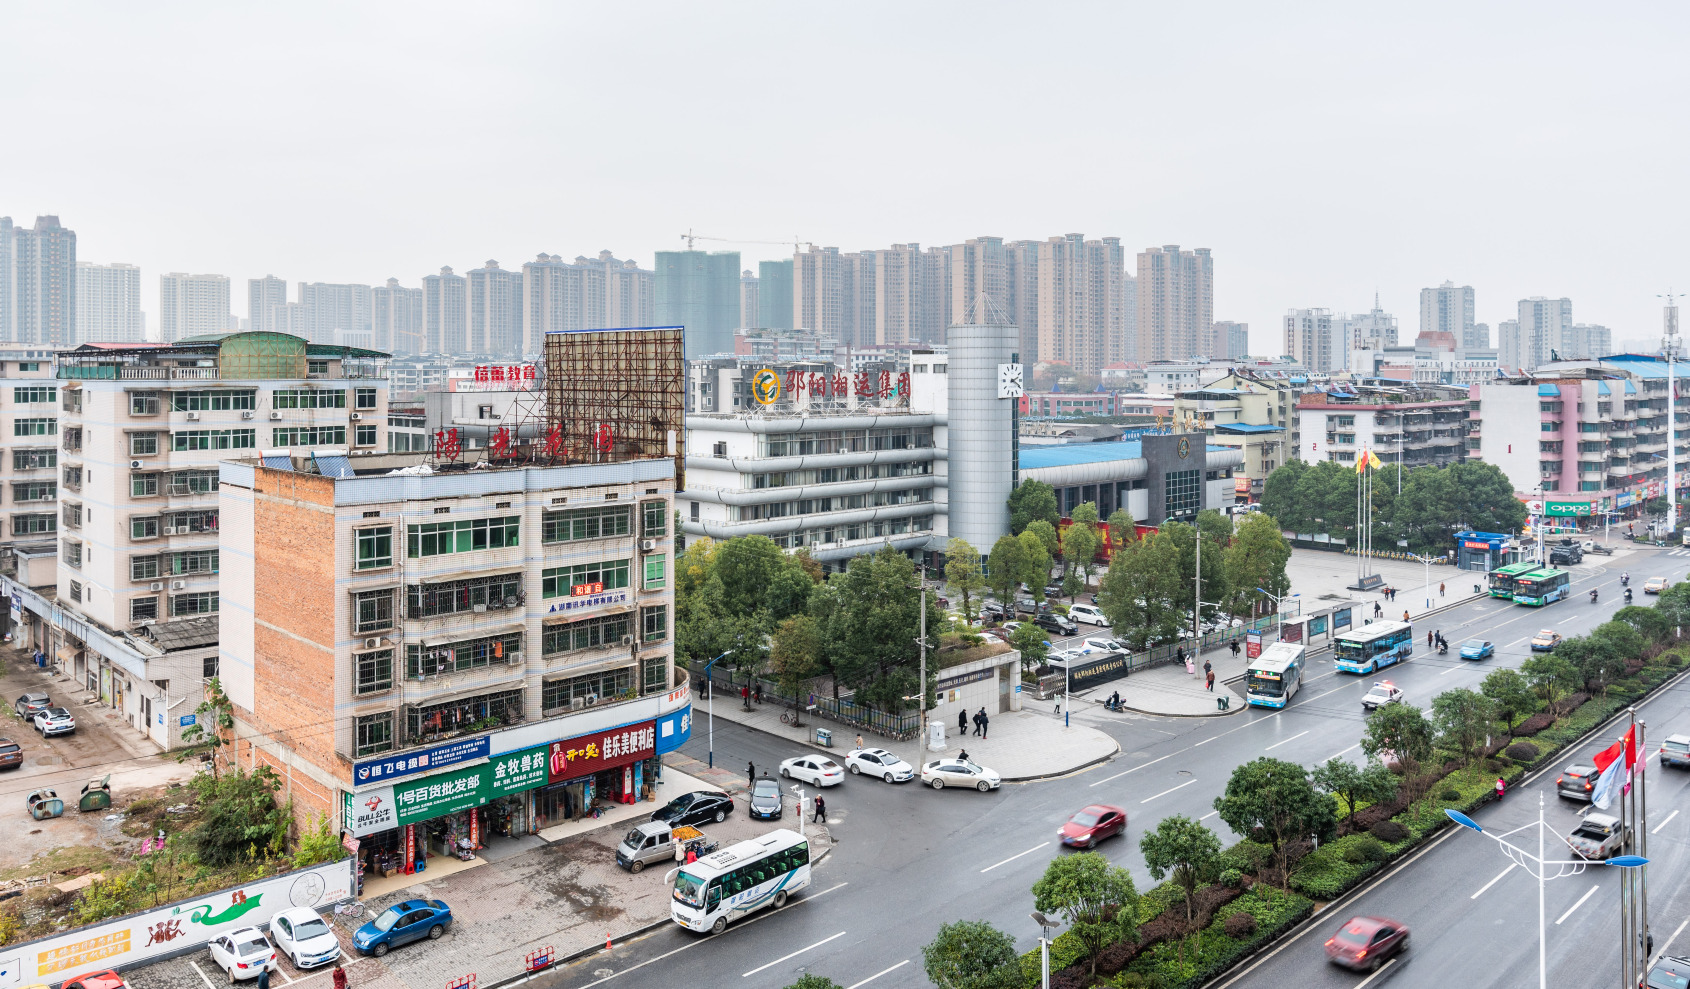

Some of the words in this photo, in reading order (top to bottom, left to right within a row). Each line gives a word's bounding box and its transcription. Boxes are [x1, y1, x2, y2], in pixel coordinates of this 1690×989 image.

[475, 365, 536, 382] 蓓蕾教育
[785, 369, 911, 402] 邵阳湘运集团
[566, 743, 599, 762] 开口笑
[602, 727, 655, 760] 佳乐美便利店
[372, 761, 418, 777] 恒飞电缆
[495, 752, 545, 779] 金牧兽药
[397, 774, 480, 806] 1号百货批发部
